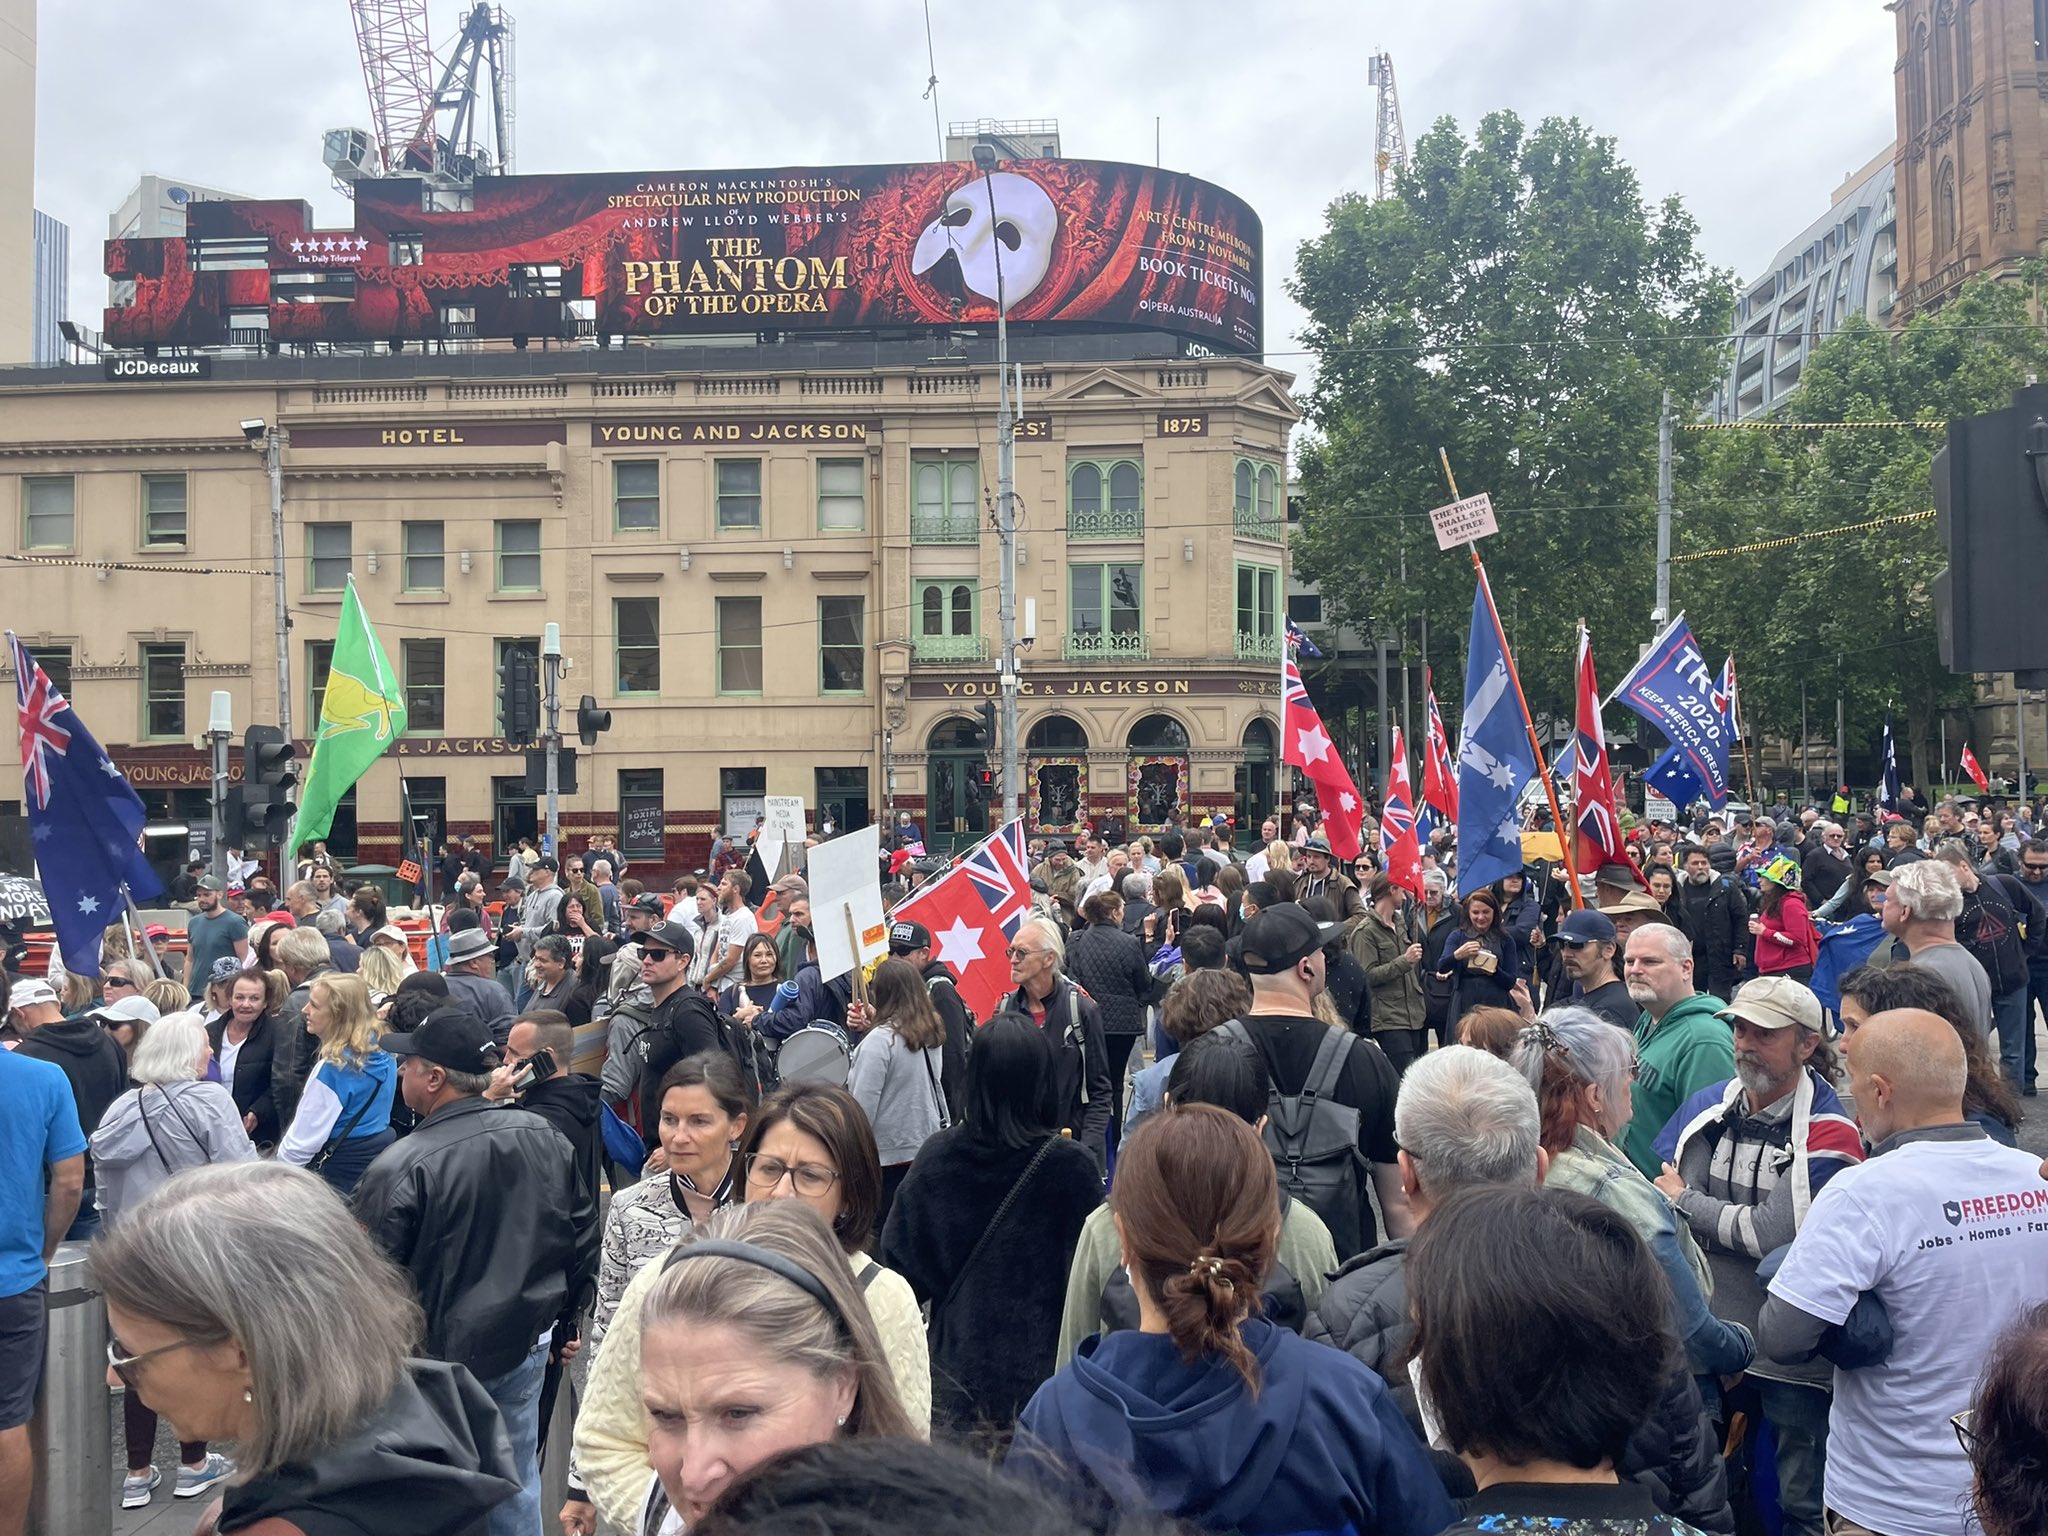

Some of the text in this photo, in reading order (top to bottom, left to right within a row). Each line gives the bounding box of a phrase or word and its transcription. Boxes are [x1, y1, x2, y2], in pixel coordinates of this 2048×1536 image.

[637, 177, 832, 193] CAMERON MACKINTOSH'S
[608, 188, 861, 209] SPECTACULAR NEW PRODUCTION
[622, 211, 848, 229] ANDREW LLOYD WEBBER'S
[729, 208, 740, 217] OF
[1137, 210, 1169, 225] ARTS
[1172, 216, 1216, 238] CENTRE
[706, 237, 763, 258] THE
[1161, 231, 1251, 273] FROM 2 NOVEMBER
[298, 254, 362, 264] The Daily Telegraph
[621, 256, 849, 297] PHANTOM
[1140, 256, 1187, 279] BOOK
[1190, 265, 1239, 296] TICKETS
[644, 292, 829, 317] OF THE OPERA
[1233, 324, 1257, 344] SOFITE
[114, 360, 200, 375] JCDecaux
[600, 423, 866, 441] YOUNG AND JACKSON
[1163, 418, 1202, 434] 1875
[381, 429, 465, 444] HOTEL
[1433, 498, 1487, 520] THE TRUTH
[1437, 507, 1487, 530] SHALL SET
[1445, 518, 1486, 537] US FREE
[943, 680, 1190, 697] YOUG & JACKSON
[1638, 685, 1664, 707] KEEP
[1660, 699, 1702, 747] AMERICA
[399, 743, 410, 754] &
[122, 765, 178, 782] YOUNG
[628, 810, 662, 821] BOXING
[775, 810, 791, 818] MEDIA
[4, 883, 31, 893] NO
[1961, 1189, 2048, 1218] FREEDOM
[1965, 1215, 1991, 1225] PARTY
[1918, 1236, 1953, 1250] Jobs
[1969, 1226, 2011, 1242] Homes
